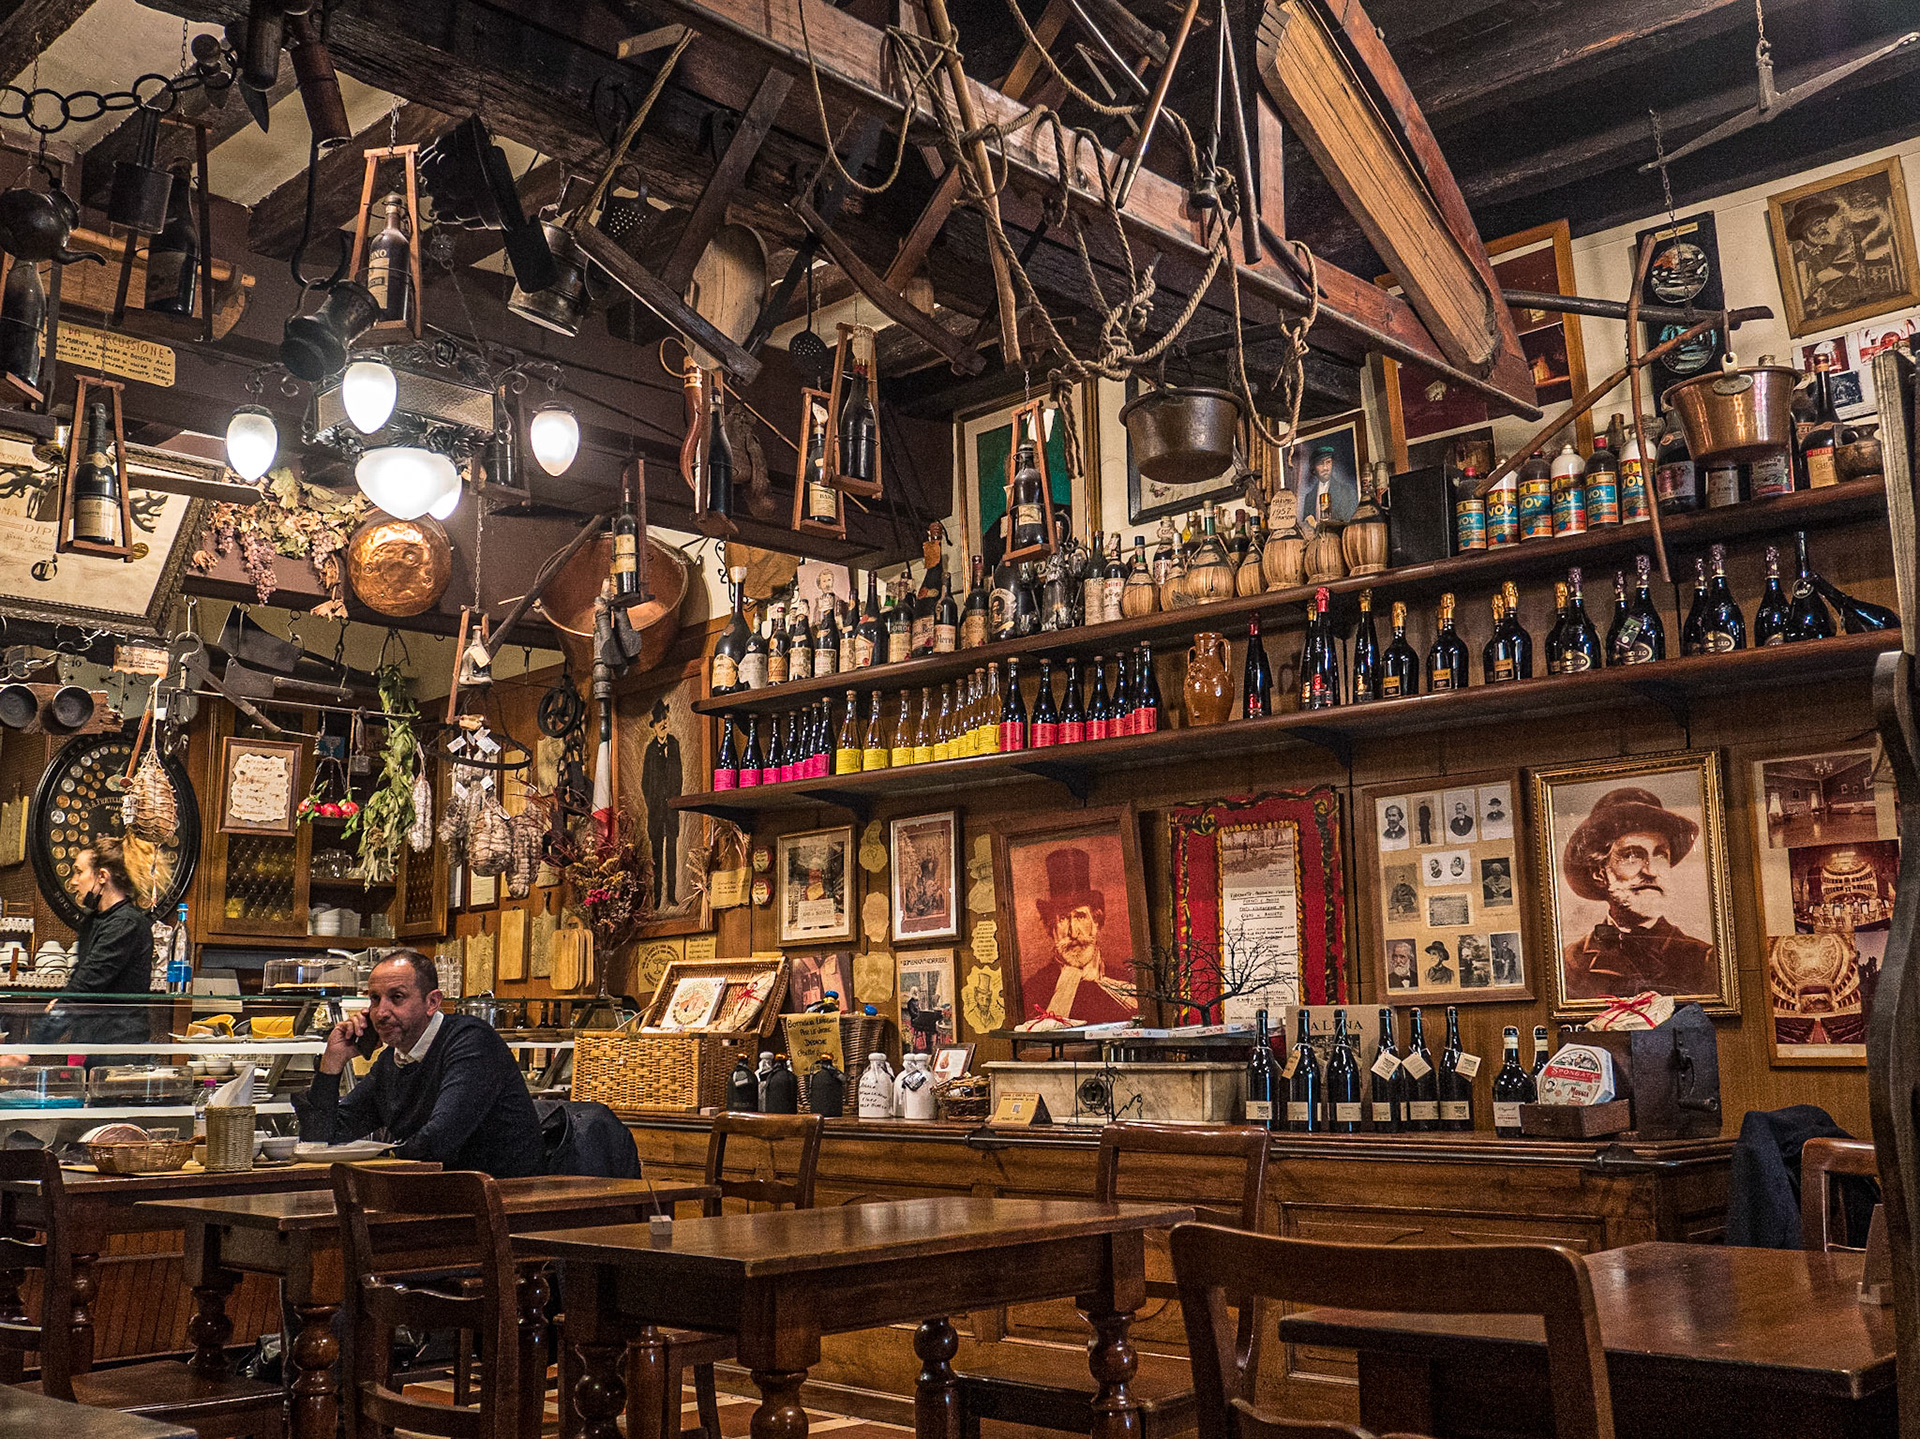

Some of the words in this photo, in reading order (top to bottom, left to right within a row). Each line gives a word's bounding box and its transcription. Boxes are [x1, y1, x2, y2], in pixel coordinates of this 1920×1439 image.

[1271, 508, 1292, 517] 1957
[1488, 504, 1513, 517] VOV
[1457, 517, 1476, 526] VOV
